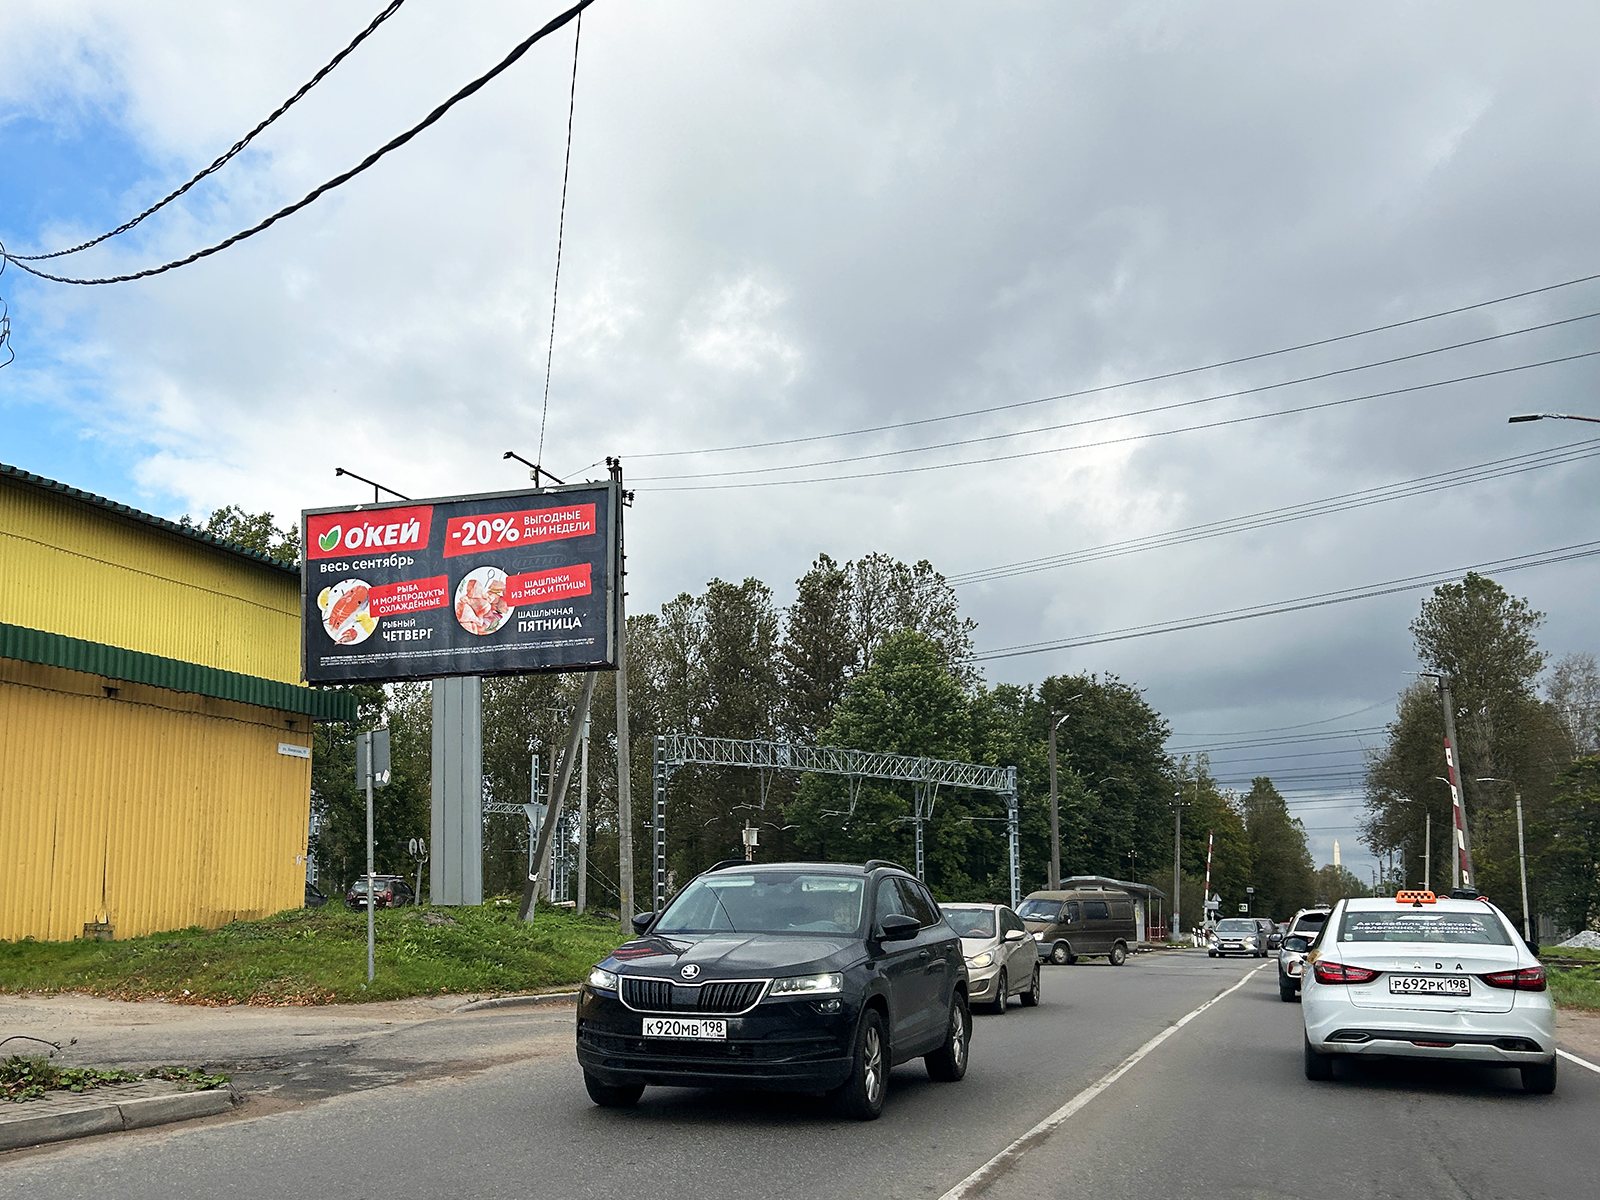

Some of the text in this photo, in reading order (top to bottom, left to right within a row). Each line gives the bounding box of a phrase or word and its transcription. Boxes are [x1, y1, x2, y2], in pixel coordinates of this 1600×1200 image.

[523, 510, 581, 525] ВЫГОДНЫЕ
[452, 516, 520, 547] -20%
[523, 519, 591, 539] ДНИ НЕДЕЛИ
[320, 552, 415, 573] весь сентябрь
[396, 583, 419, 593] РЫБА
[511, 578, 587, 599] ИЗ МЯСА И ПТИЦЫ
[524, 574, 570, 587] ШАШЛЫКИ
[372, 588, 445, 606] И МОРЕПРОДУКТЫ
[517, 606, 575, 619] ШАШЛЫЧНАЯ
[382, 617, 416, 629] РЫБНЫЙ
[517, 616, 583, 633] ПЯТНИЦА
[382, 628, 434, 642] ЧЕТВЕРГ
